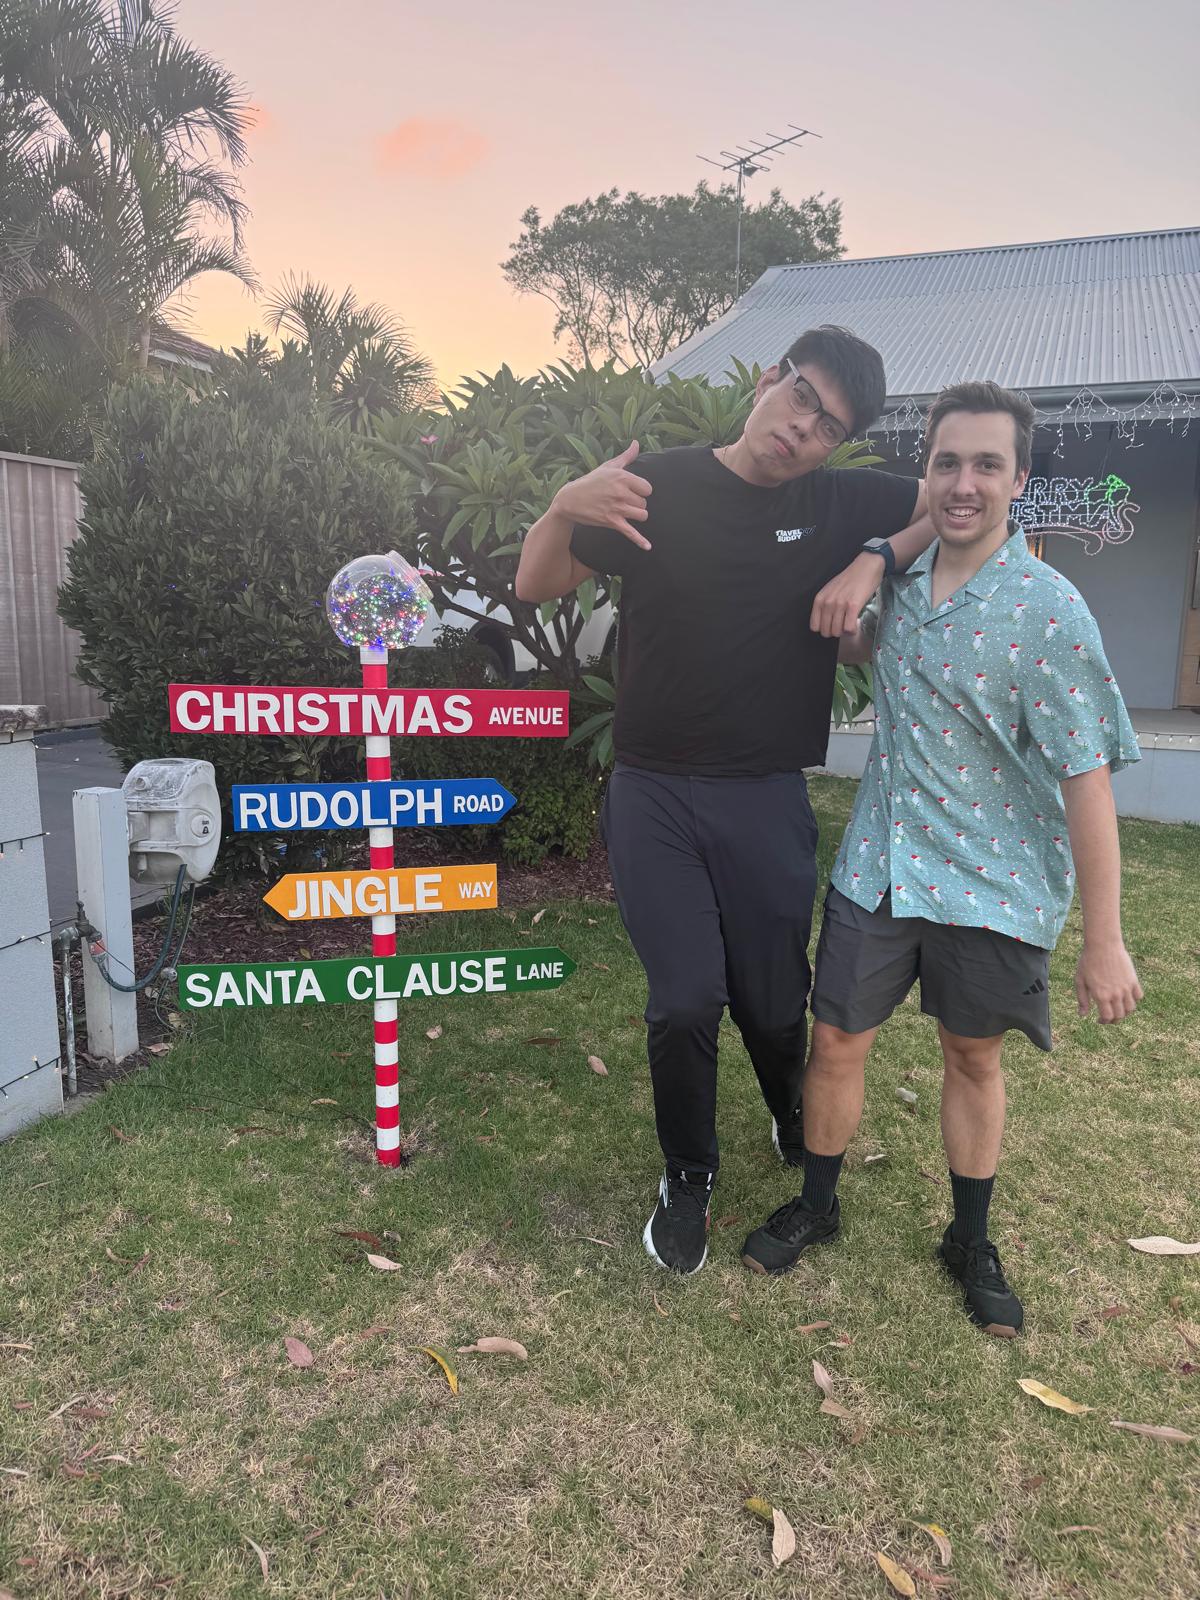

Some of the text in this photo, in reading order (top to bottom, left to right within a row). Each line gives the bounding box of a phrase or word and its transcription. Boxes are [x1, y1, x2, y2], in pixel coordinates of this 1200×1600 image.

[777, 534, 802, 542] BUDDY
[176, 690, 563, 734] CHRISTMAS AVENUE
[238, 788, 504, 829] RUDOLPH ROAD
[288, 873, 493, 918] JINGLE WAY
[185, 957, 564, 1008] SANTA CLAUSE LANE
